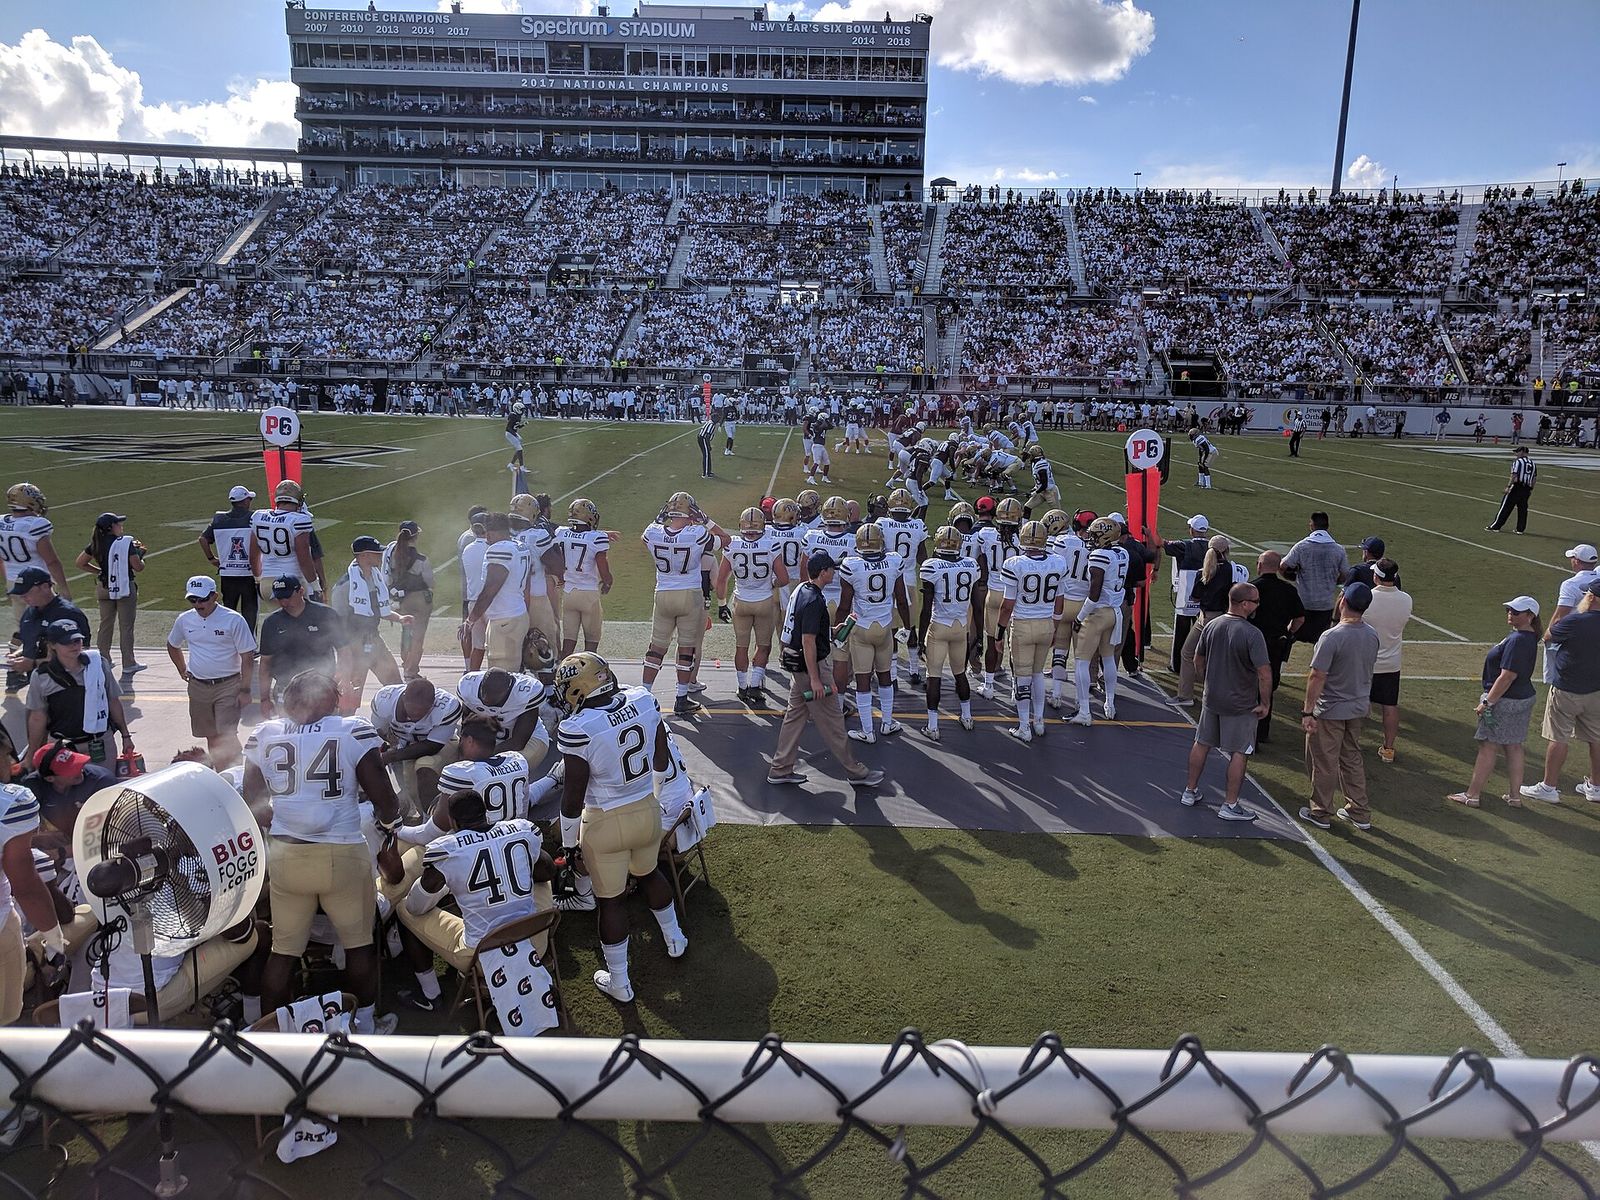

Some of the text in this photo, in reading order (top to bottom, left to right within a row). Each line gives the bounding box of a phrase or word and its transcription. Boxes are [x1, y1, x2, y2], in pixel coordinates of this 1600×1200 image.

[304, 11, 450, 24] CONFERENCE CHAMPIONS
[521, 16, 695, 38] Spectrum STADIUM
[750, 22, 911, 35] NEW YEAR'S SIX BOWL WINS
[304, 23, 470, 36] 2007 2010 2013 2014 2017
[852, 36, 910, 46] 2014 2018
[521, 78, 729, 92] 2017 NATIONAL CHAMPIONS
[266, 416, 292, 435] P6
[1132, 440, 1158, 459] P6
[1526, 463, 1533, 474] C
[564, 531, 586, 540] STREET
[888, 521, 919, 530] MATHEWS
[255, 526, 291, 557] 59
[817, 536, 848, 546] CARRIGAN
[895, 532, 911, 559] 6
[560, 542, 587, 572] 17
[654, 545, 690, 574] 57
[733, 552, 769, 580] 35
[867, 573, 887, 603] 9
[942, 571, 972, 603] 18
[1022, 573, 1061, 605] 96
[1114, 564, 1126, 592] 5
[558, 664, 578, 680] Pitt
[607, 703, 639, 727] GREEN
[283, 723, 321, 734] WATTS
[618, 724, 650, 785] 2
[265, 739, 343, 800] 34
[486, 761, 523, 777] WHEELER
[483, 776, 527, 820] 90
[457, 823, 521, 847] FOLSTON JR.
[212, 832, 254, 865] BIG
[219, 851, 257, 883] FOGG
[467, 838, 532, 906] 40
[224, 868, 254, 893] .com
[491, 965, 507, 988] G
[518, 975, 532, 995] G
[508, 1004, 523, 1027] G
